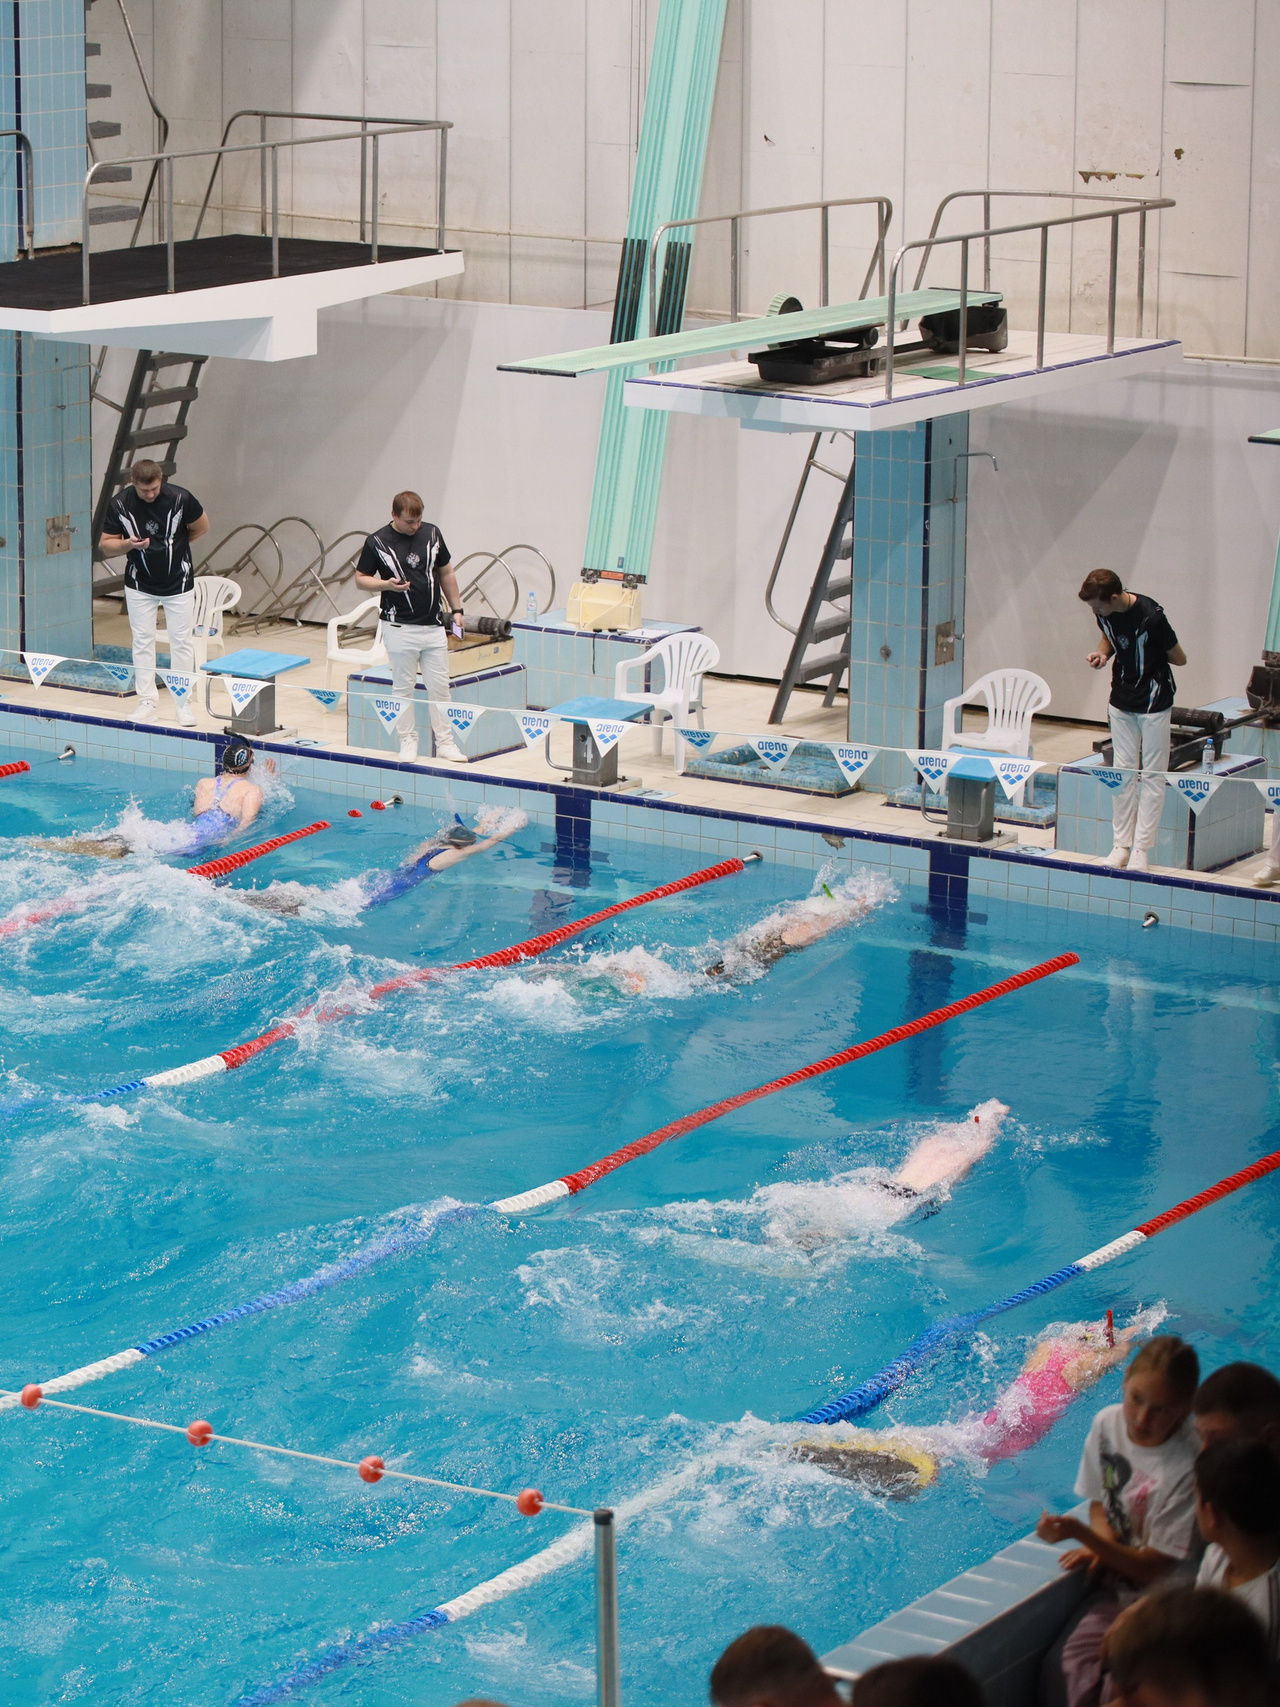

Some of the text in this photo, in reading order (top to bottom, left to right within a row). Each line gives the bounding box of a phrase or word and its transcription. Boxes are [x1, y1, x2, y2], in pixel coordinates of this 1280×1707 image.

[31, 657, 56, 667] arena
[166, 674, 190, 687] arena
[231, 682, 258, 692] arena
[375, 699, 401, 712] arena
[447, 708, 473, 720] arena
[521, 716, 550, 728] arena
[596, 722, 625, 734] arena
[681, 729, 711, 739] arena
[757, 740, 788, 752] arena
[838, 748, 869, 760] arena
[918, 756, 948, 768] arena
[999, 762, 1031, 773] arena
[1091, 769, 1123, 782] arena
[1177, 779, 1210, 791] arena
